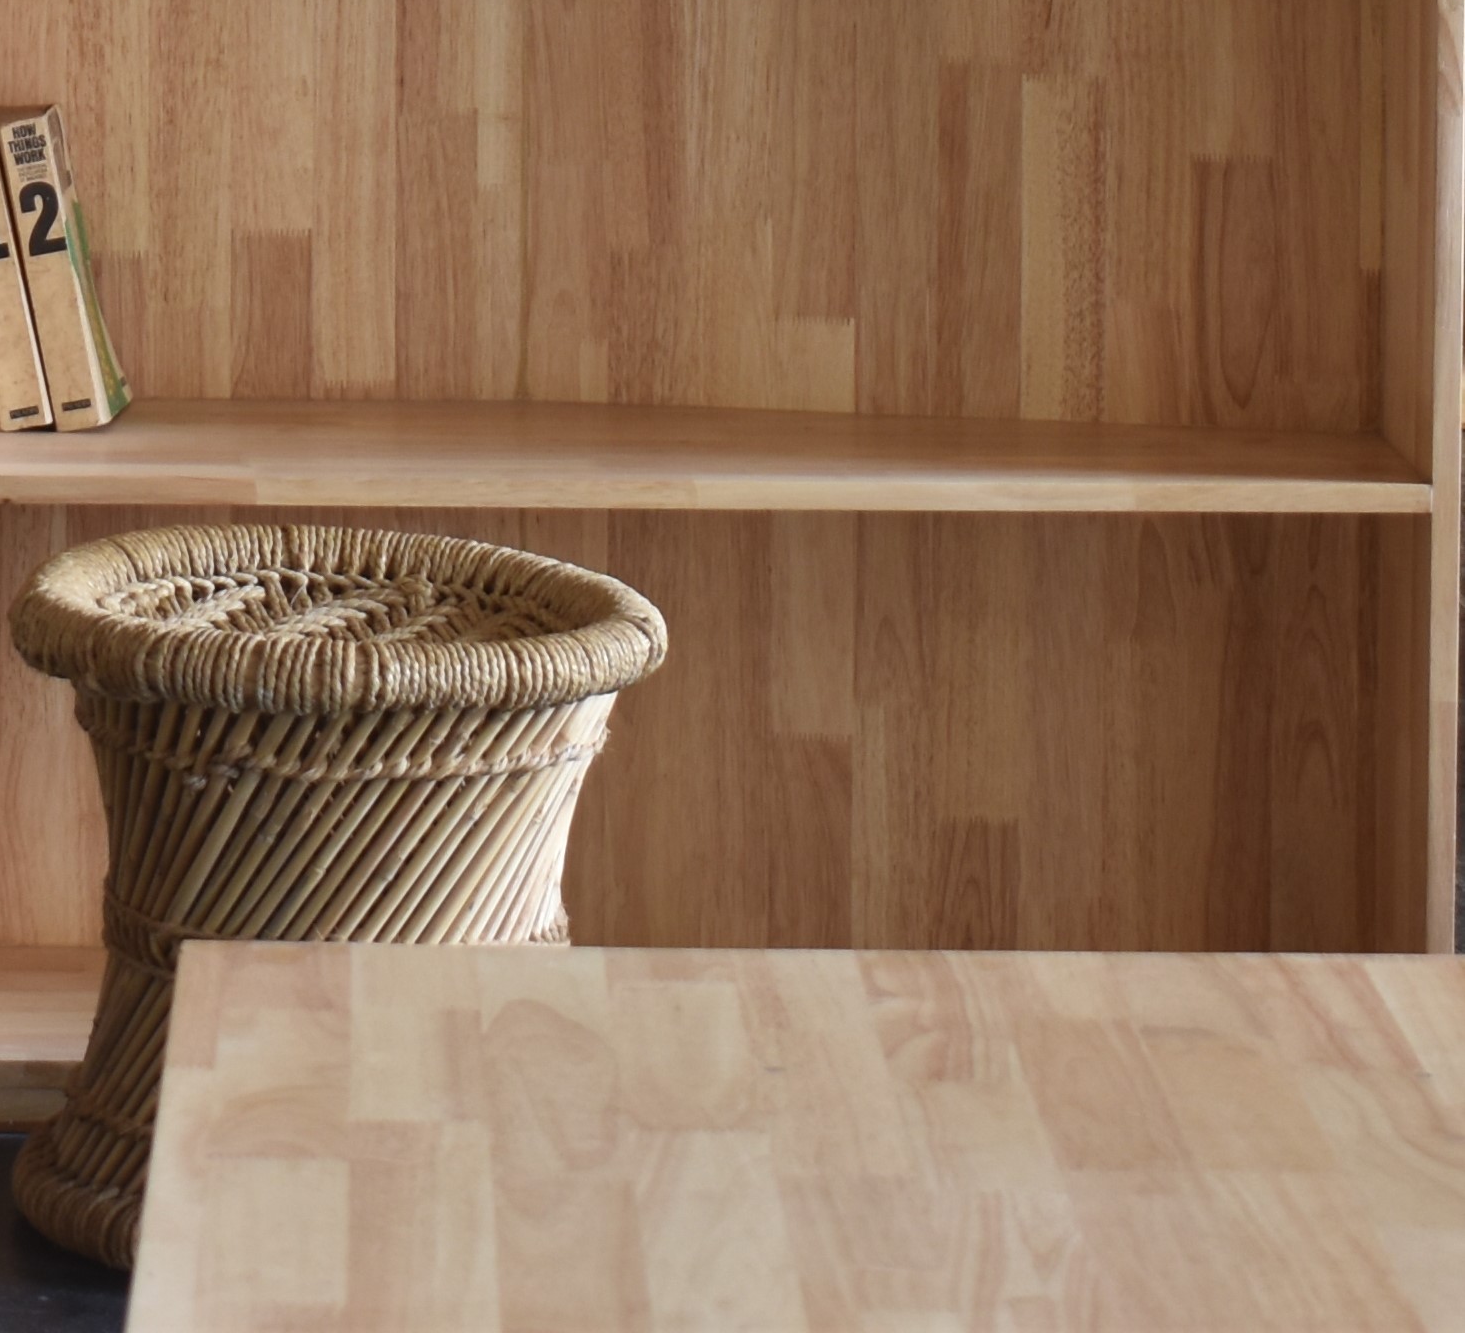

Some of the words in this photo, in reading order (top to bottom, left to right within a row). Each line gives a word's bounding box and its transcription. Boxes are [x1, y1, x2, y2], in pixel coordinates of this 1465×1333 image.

[12, 123, 36, 139] HOW
[8, 135, 46, 153] THINGS
[14, 149, 46, 165] WORK
[19, 181, 67, 256] 2
